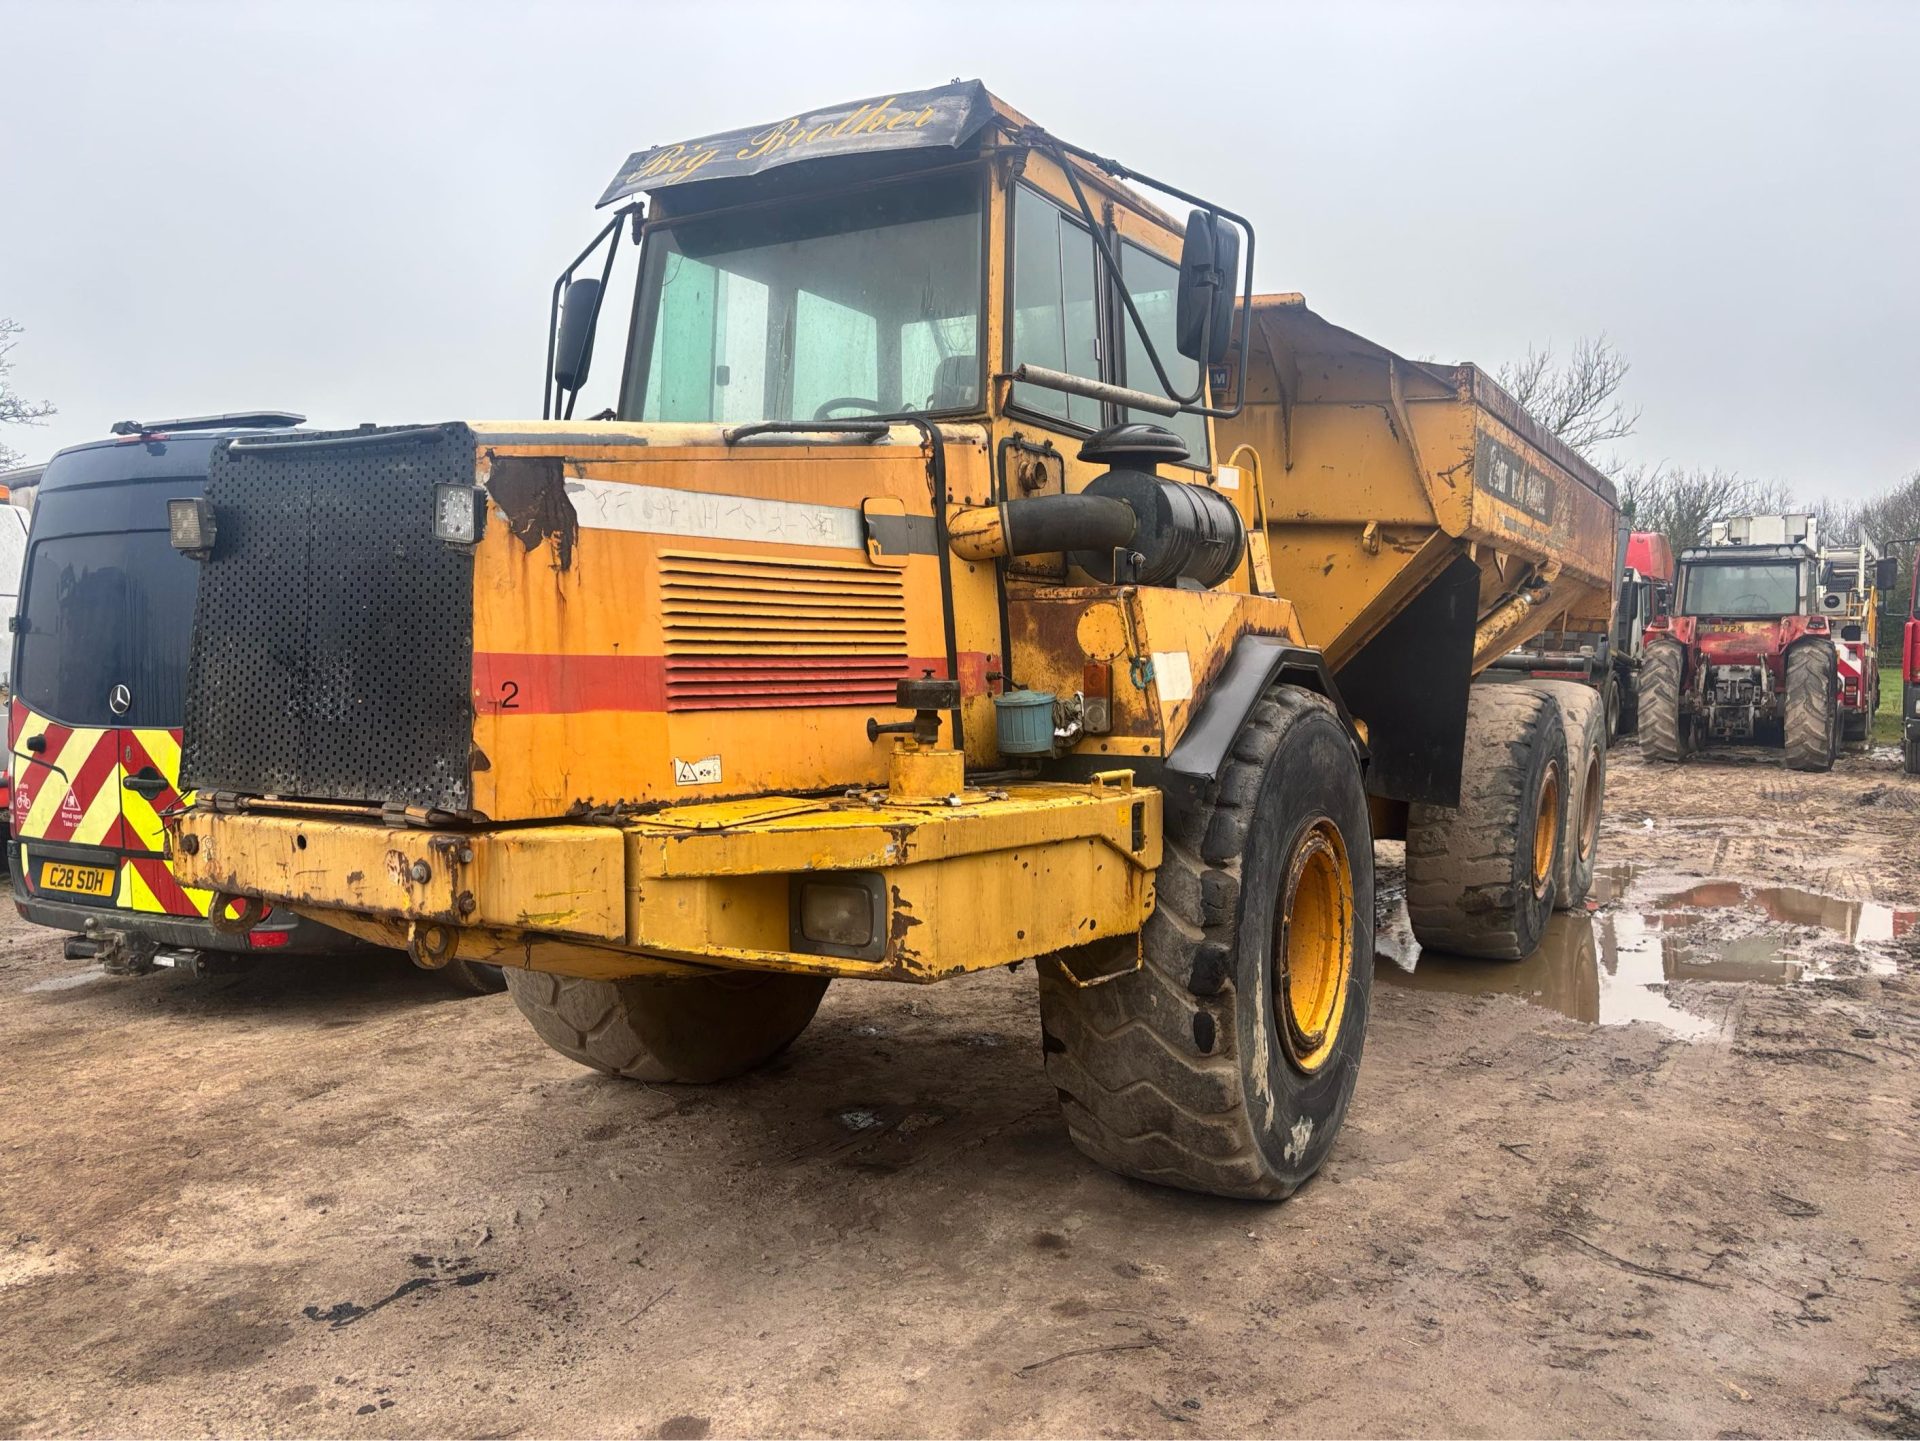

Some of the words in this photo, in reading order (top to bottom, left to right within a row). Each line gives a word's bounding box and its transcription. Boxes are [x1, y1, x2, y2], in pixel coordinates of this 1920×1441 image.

[627, 144, 720, 185] Big
[736, 97, 935, 160] Brother
[501, 681, 519, 708] 2
[50, 867, 75, 888] C28
[76, 870, 104, 891] SDH
